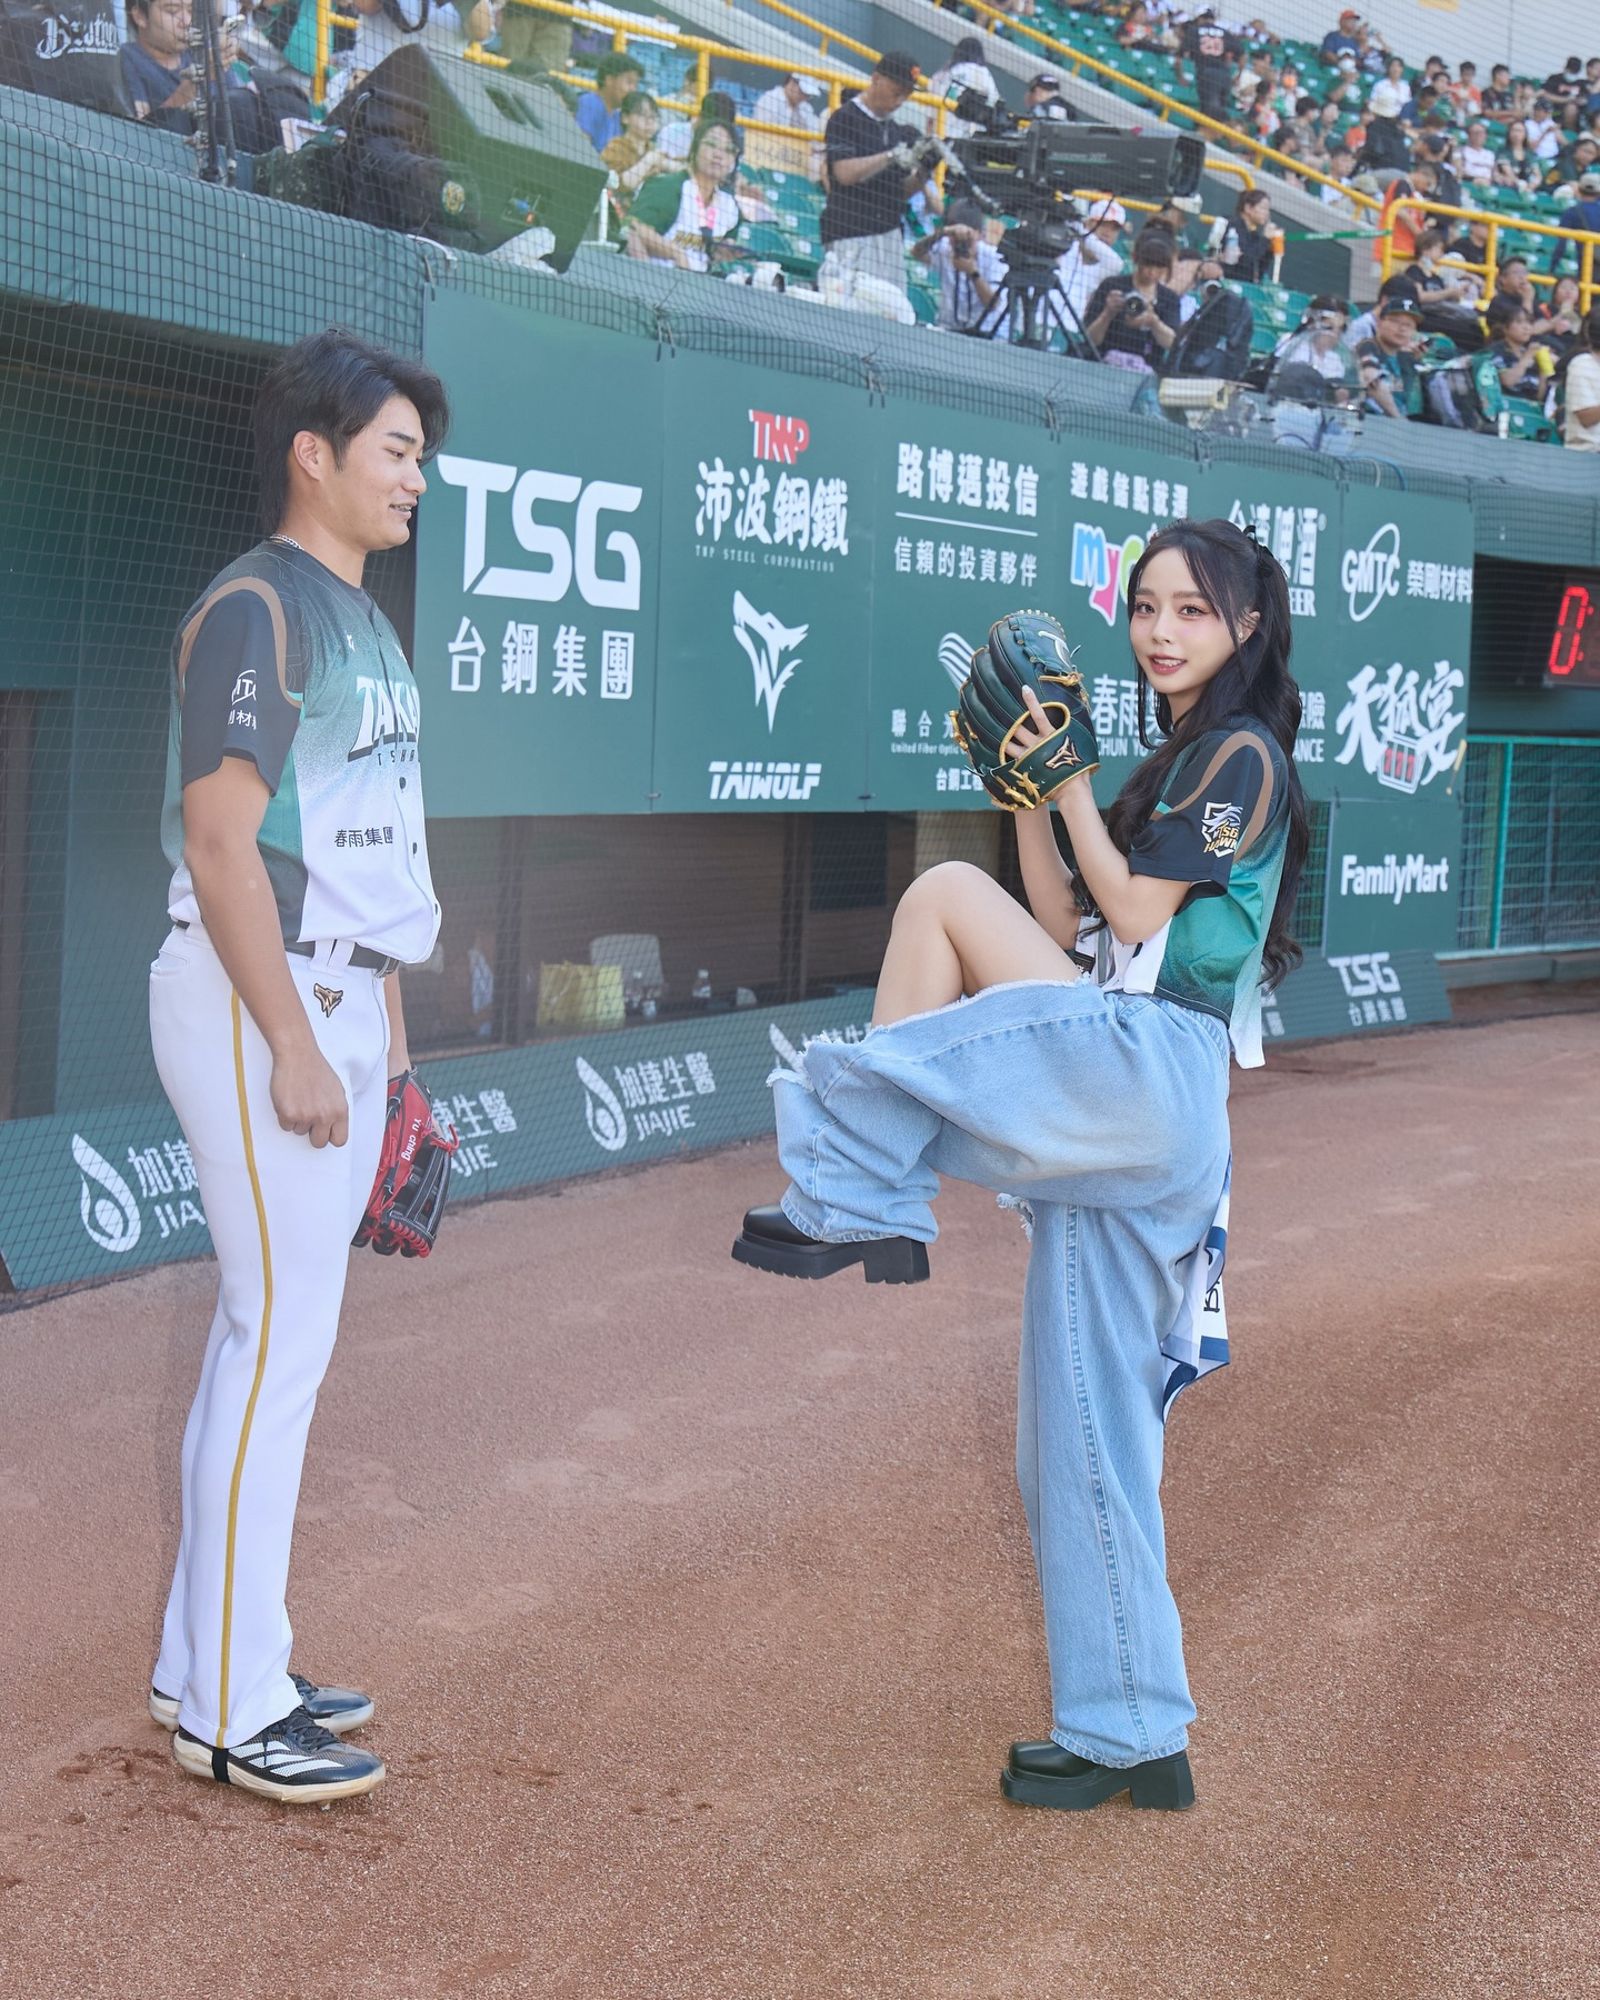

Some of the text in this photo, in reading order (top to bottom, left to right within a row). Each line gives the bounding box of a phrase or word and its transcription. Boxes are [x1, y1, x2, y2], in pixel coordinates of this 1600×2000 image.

[897, 442, 1039, 517] 路博邁投信
[695, 457, 849, 556] 沛波鋼鐵
[437, 454, 643, 611] TSG
[723, 548, 757, 564] STEEL
[763, 553, 835, 573] CORPORATION
[895, 536, 1037, 587] 信賴的投資夥伴
[1341, 548, 1400, 597] GMTC
[447, 616, 635, 700] 台鋼集團
[918, 743, 937, 754] Fiber
[708, 761, 822, 800] TAIWOLF
[1341, 853, 1449, 905] FamilyMart
[1327, 951, 1402, 997] TSG
[633, 1104, 696, 1142] JIAJIE
[153, 1199, 208, 1239] JIA
